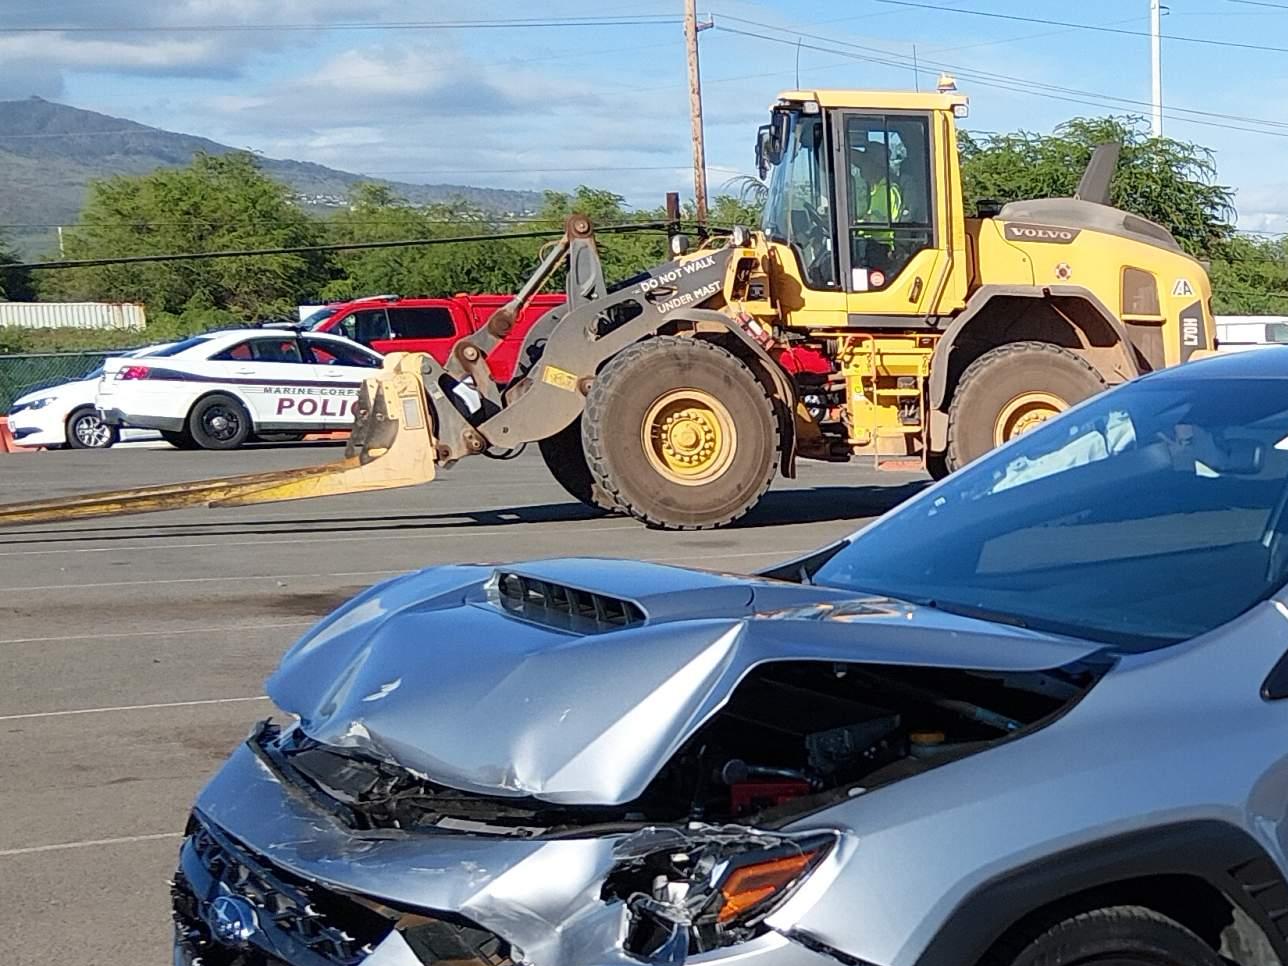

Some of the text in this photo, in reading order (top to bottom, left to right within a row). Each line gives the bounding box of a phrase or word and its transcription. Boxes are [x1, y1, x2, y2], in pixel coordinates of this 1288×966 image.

[1010, 227, 1072, 240] VOLVO
[640, 255, 716, 292] DO NOT WALK
[657, 280, 721, 314] UNDER MAST
[1183, 317, 1198, 346] L70H
[263, 387, 313, 396] MARINE
